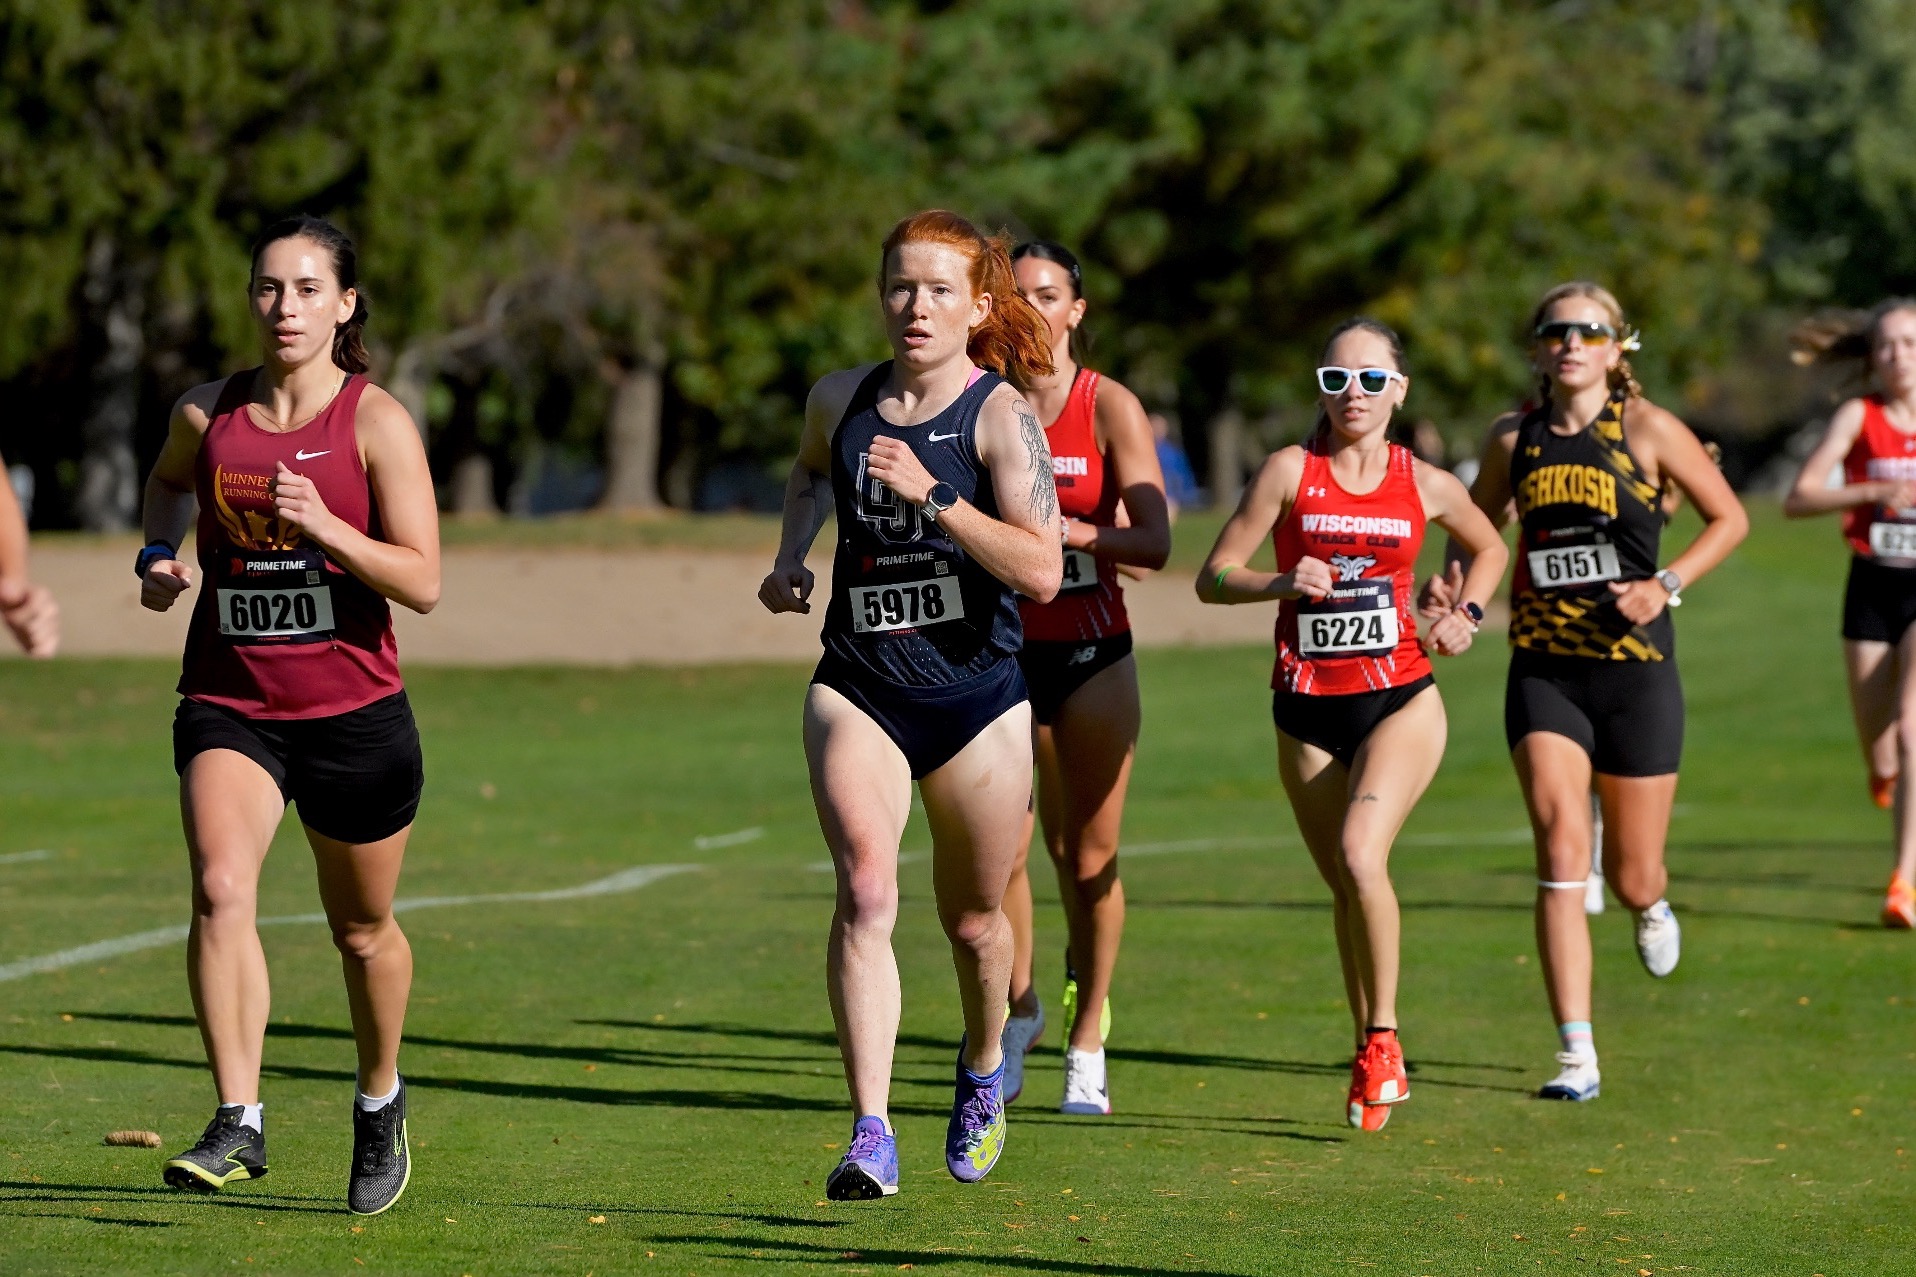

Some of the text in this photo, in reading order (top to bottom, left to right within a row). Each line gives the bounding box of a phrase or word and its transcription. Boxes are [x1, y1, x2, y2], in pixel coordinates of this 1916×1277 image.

[222, 472, 273, 488] MINNES
[223, 487, 266, 500] RUNNING
[1302, 513, 1411, 538] WISCONSIN
[246, 560, 307, 571] PRIMETIME
[876, 551, 935, 567] PRIMETIME
[1546, 549, 1602, 581] 6151
[229, 592, 318, 632] 6020
[862, 583, 946, 628] 5978
[1311, 615, 1385, 648] 6224
